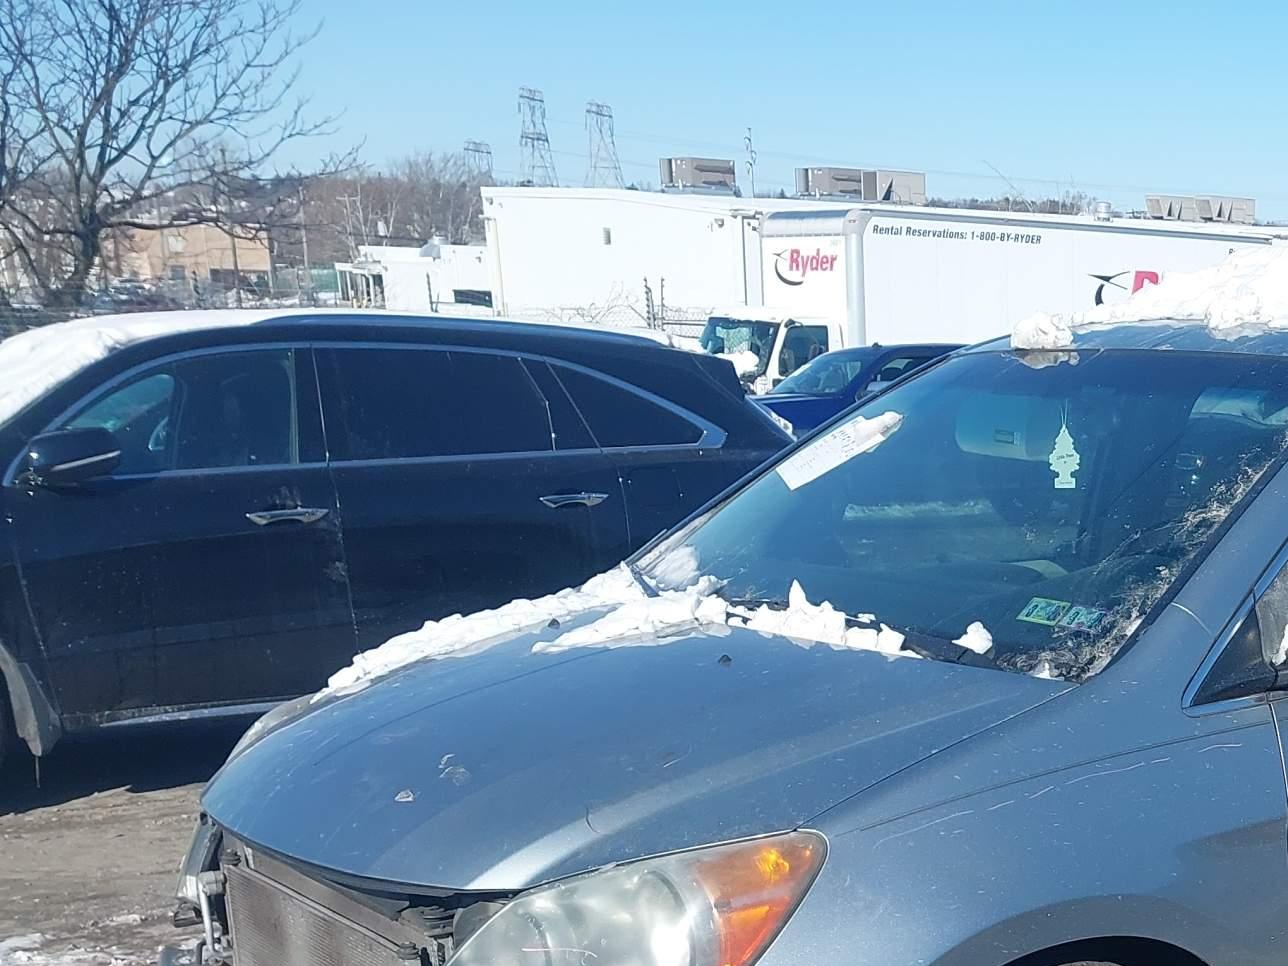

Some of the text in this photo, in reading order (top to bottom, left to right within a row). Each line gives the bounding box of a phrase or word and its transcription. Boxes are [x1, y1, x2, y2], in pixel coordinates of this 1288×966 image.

[872, 224, 1042, 245] Rental Reservations: 1-800-BY-RYDER
[788, 248, 838, 278] Ryder
